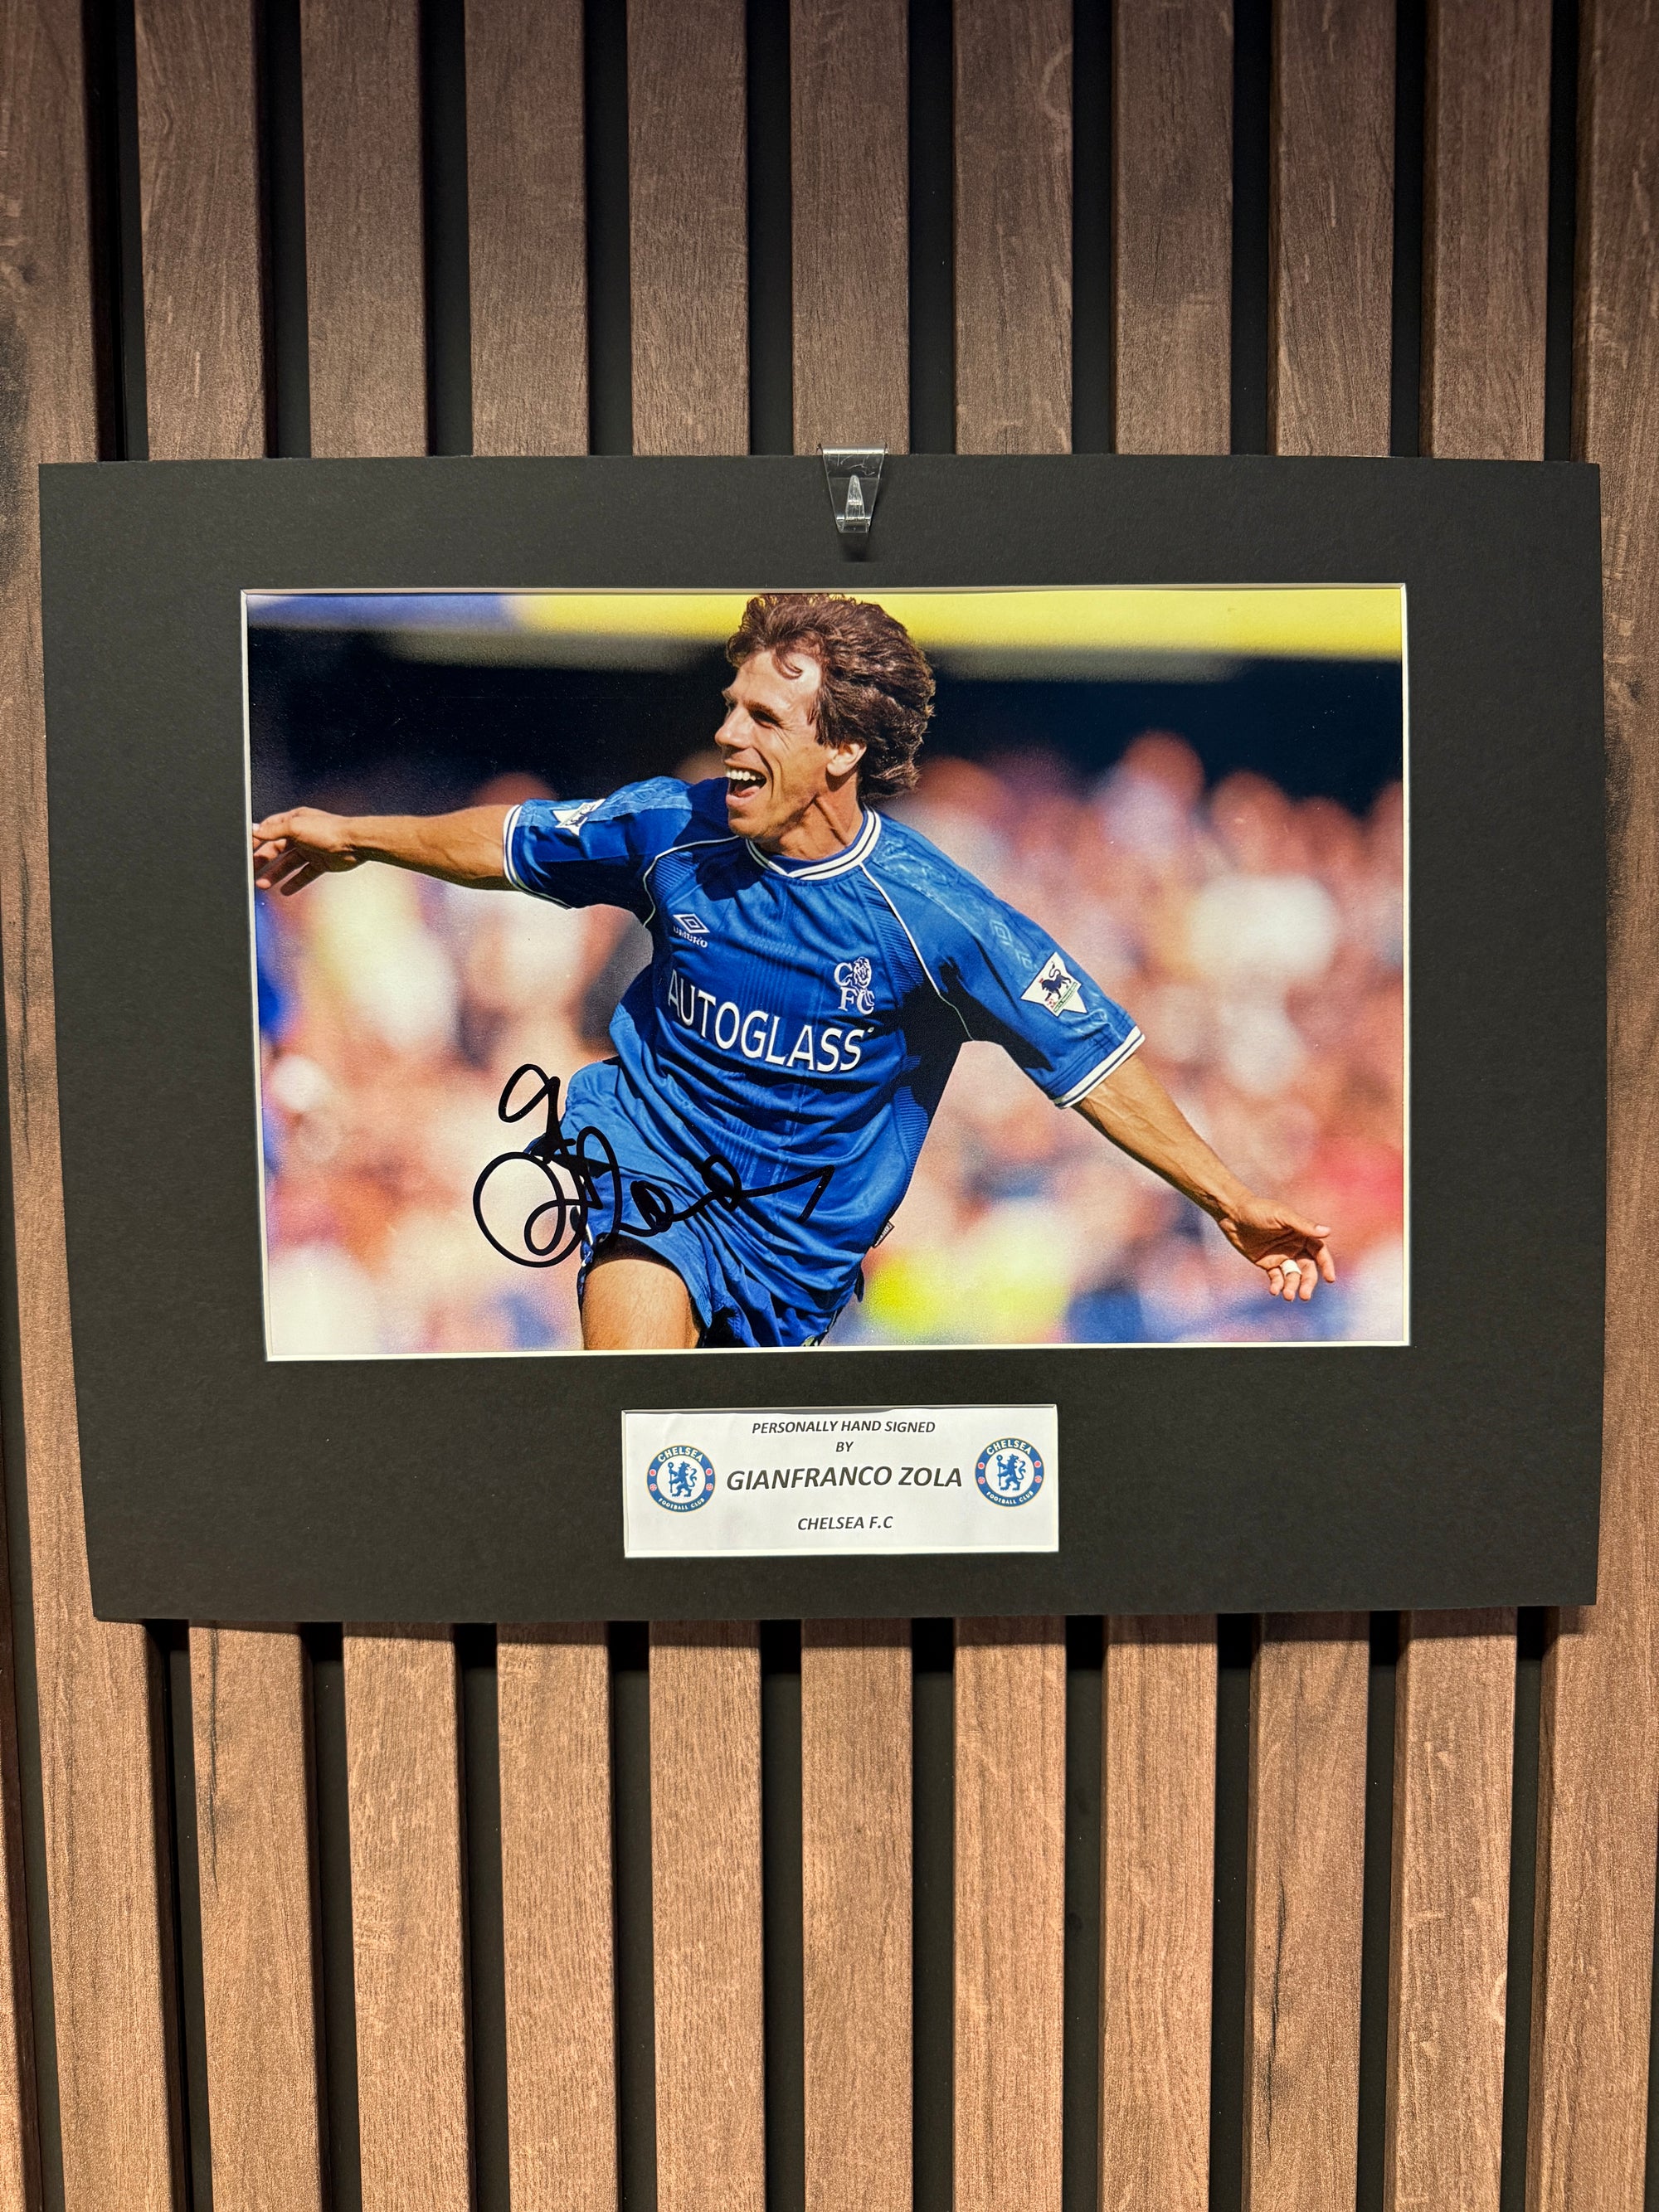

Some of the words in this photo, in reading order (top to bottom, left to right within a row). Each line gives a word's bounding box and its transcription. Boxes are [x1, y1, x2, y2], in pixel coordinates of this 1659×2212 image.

[673, 926, 708, 948] UMBRO
[668, 969, 864, 1072] AUTOGLASS
[752, 1422, 838, 1433] PERSONALLY
[841, 1421, 881, 1431] HAND
[885, 1422, 935, 1432] SIGNED
[658, 1446, 703, 1462] CHELSEA
[836, 1442, 853, 1451] BY
[986, 1439, 1032, 1456] CHELSEA
[727, 1466, 892, 1490] GIANFRANCO
[898, 1467, 961, 1486] ZOLA
[658, 1497, 688, 1510] FOOTBALL
[690, 1497, 705, 1508] CLUB
[986, 1491, 1017, 1505] FOOTBALL
[1019, 1490, 1034, 1502] CLUB
[798, 1517, 864, 1529] CHELSEA
[869, 1516, 893, 1528] F.C
